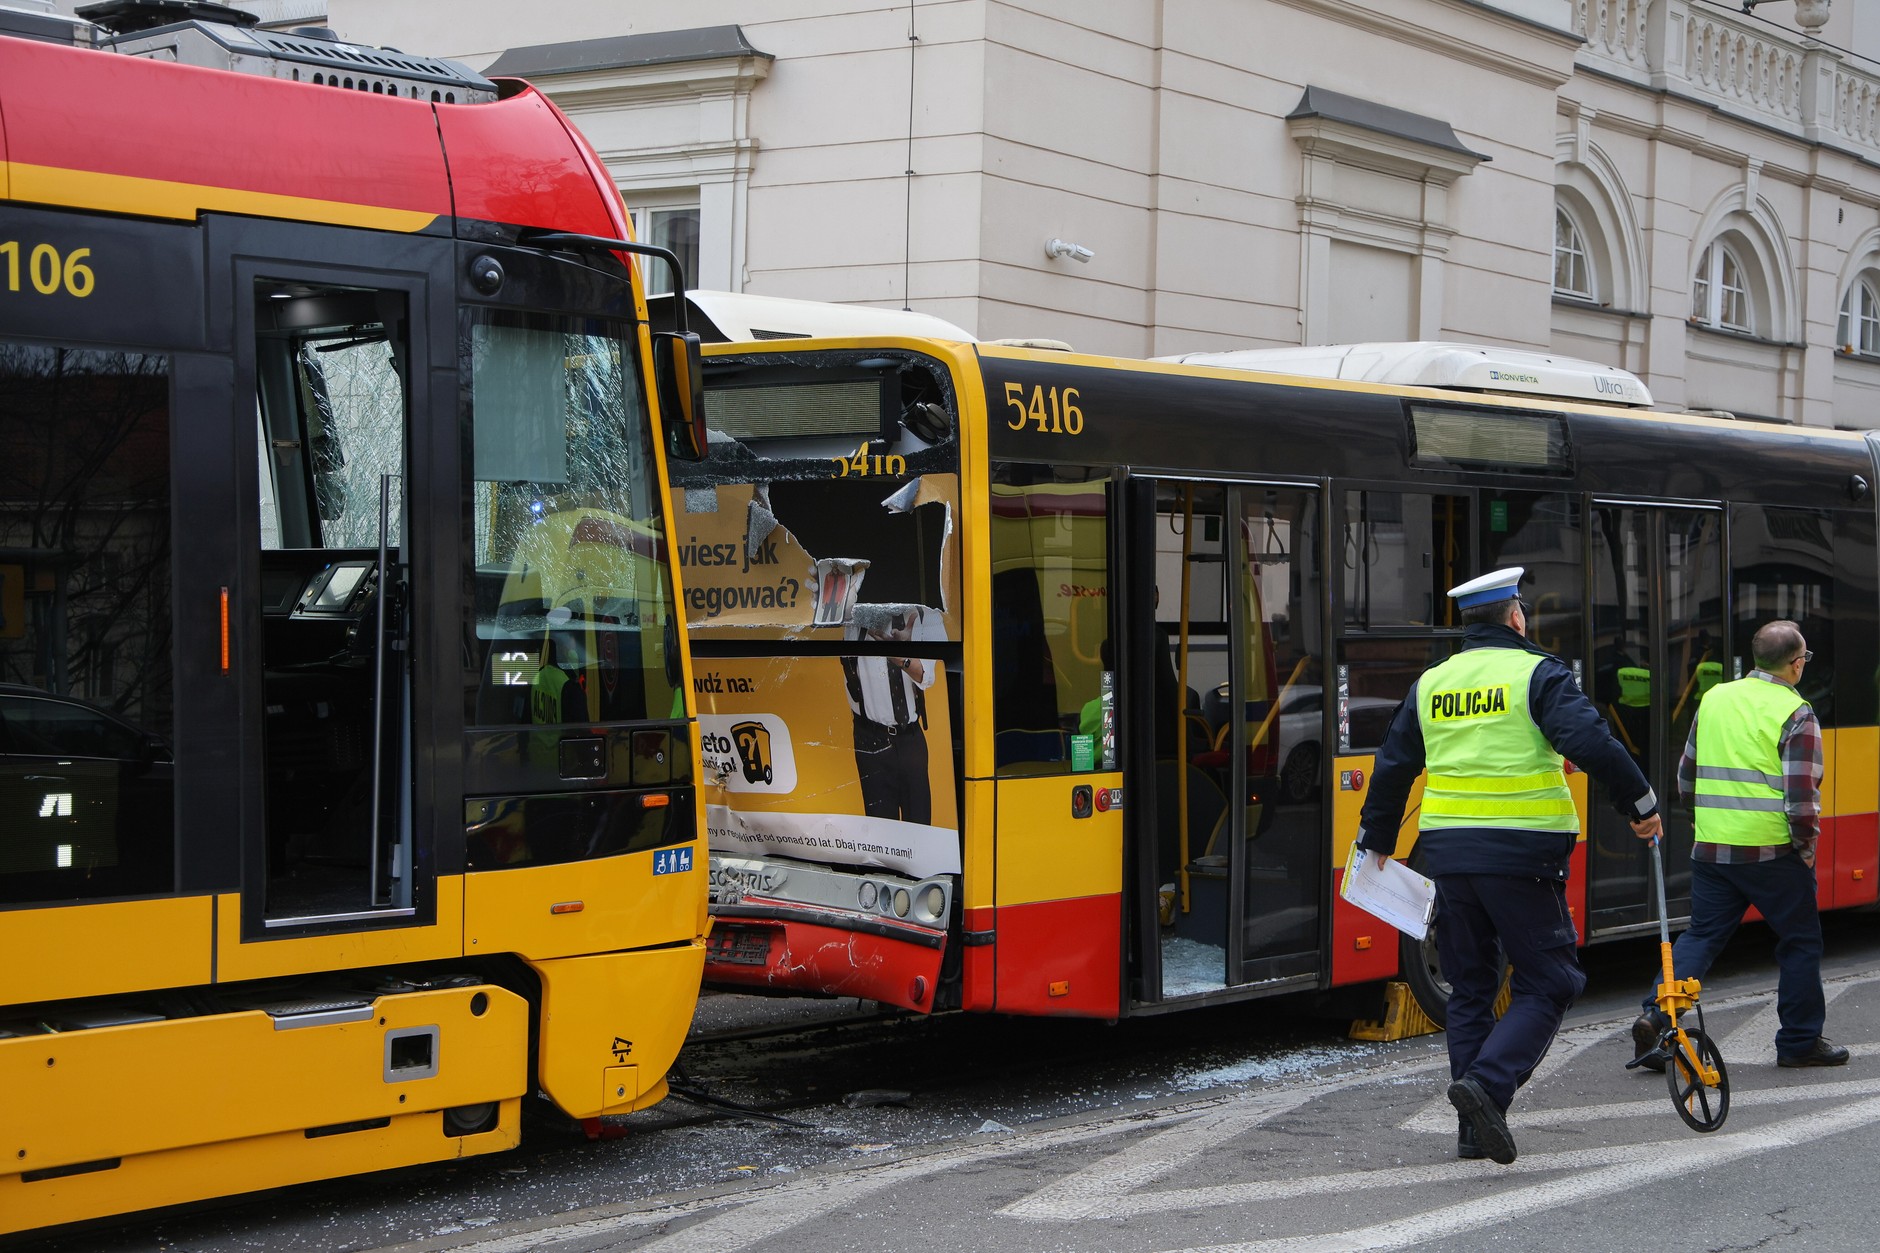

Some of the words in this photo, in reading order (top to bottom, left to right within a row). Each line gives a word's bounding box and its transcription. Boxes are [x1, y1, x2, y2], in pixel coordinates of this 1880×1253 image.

[0, 240, 95, 298] 106
[1499, 372, 1539, 385] KONVEKTA
[1004, 381, 1084, 436] 5416
[728, 677, 755, 693] na:
[1432, 688, 1506, 719] POLICJA
[720, 828, 726, 836] o
[764, 833, 775, 842] od
[776, 834, 804, 846] ponad
[805, 835, 818, 847] 20
[819, 837, 835, 849] lat.
[835, 838, 856, 852] Dbaj
[857, 841, 884, 855] razem
[885, 847, 890, 855] z
[891, 847, 914, 860] nami!
